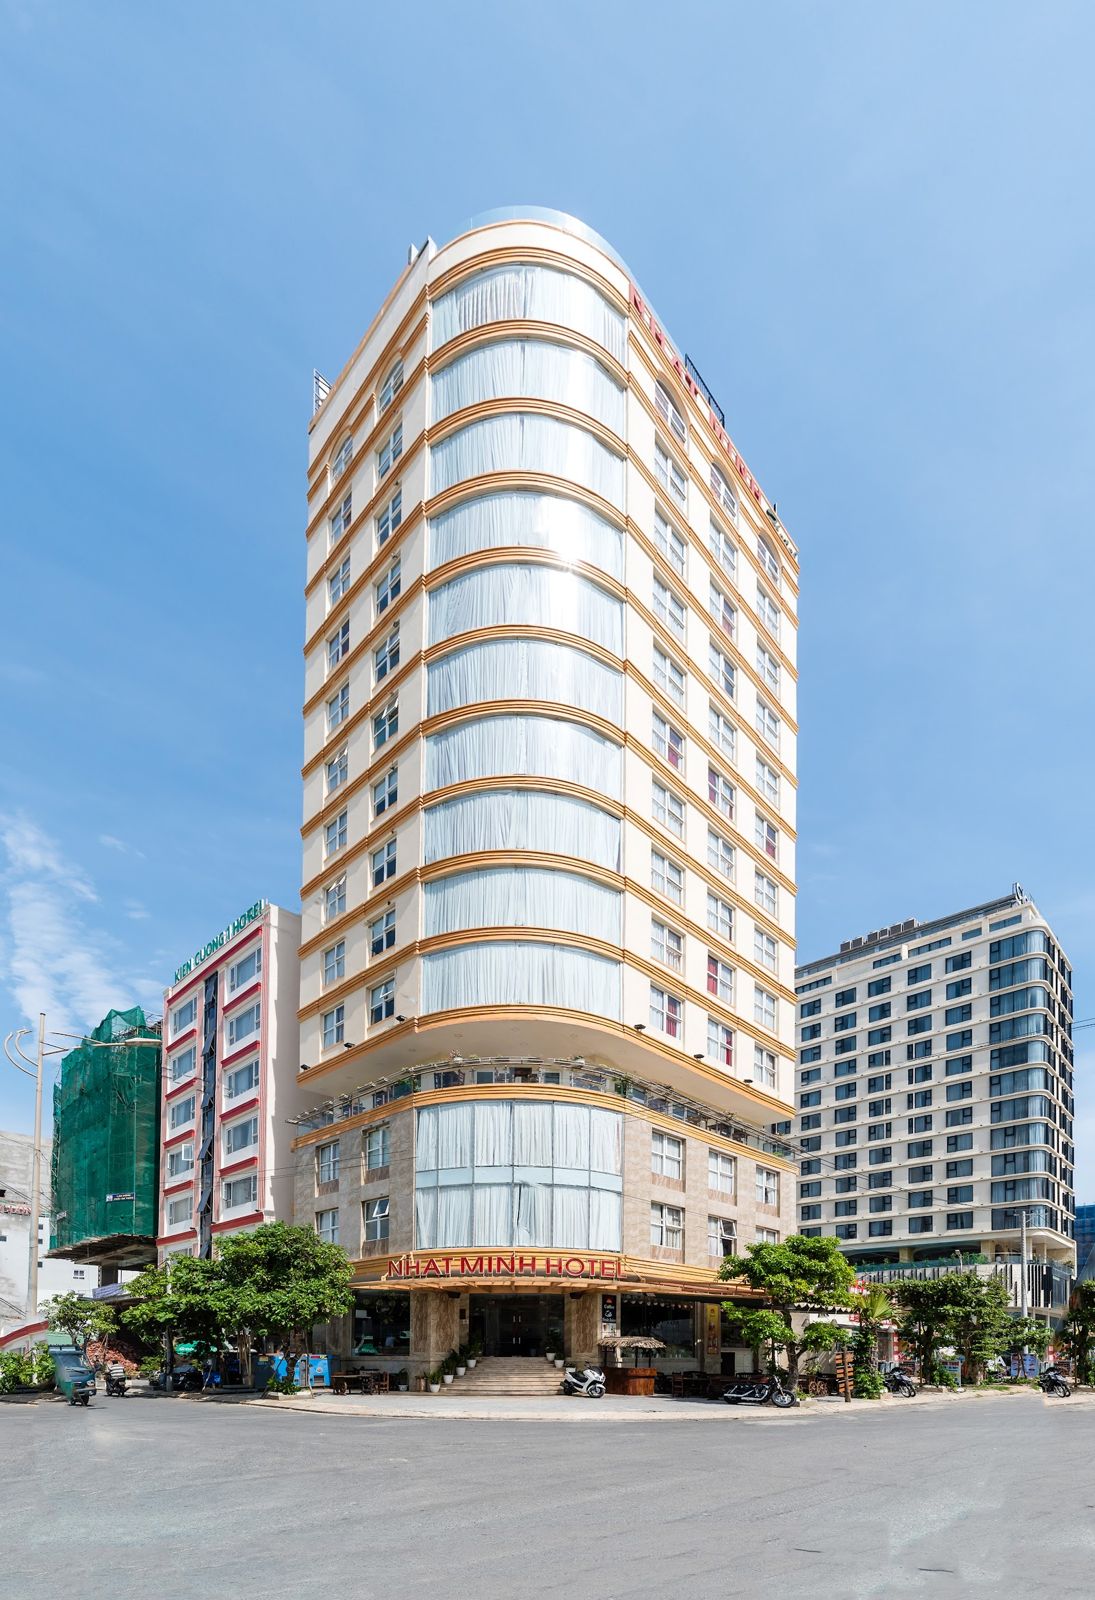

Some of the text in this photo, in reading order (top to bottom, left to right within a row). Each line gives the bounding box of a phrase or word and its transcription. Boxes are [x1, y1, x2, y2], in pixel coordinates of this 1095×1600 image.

[174, 958, 192, 984] KIEN
[194, 931, 225, 966] CUONG
[387, 1255, 628, 1279] NHAT MINH HOTEL
